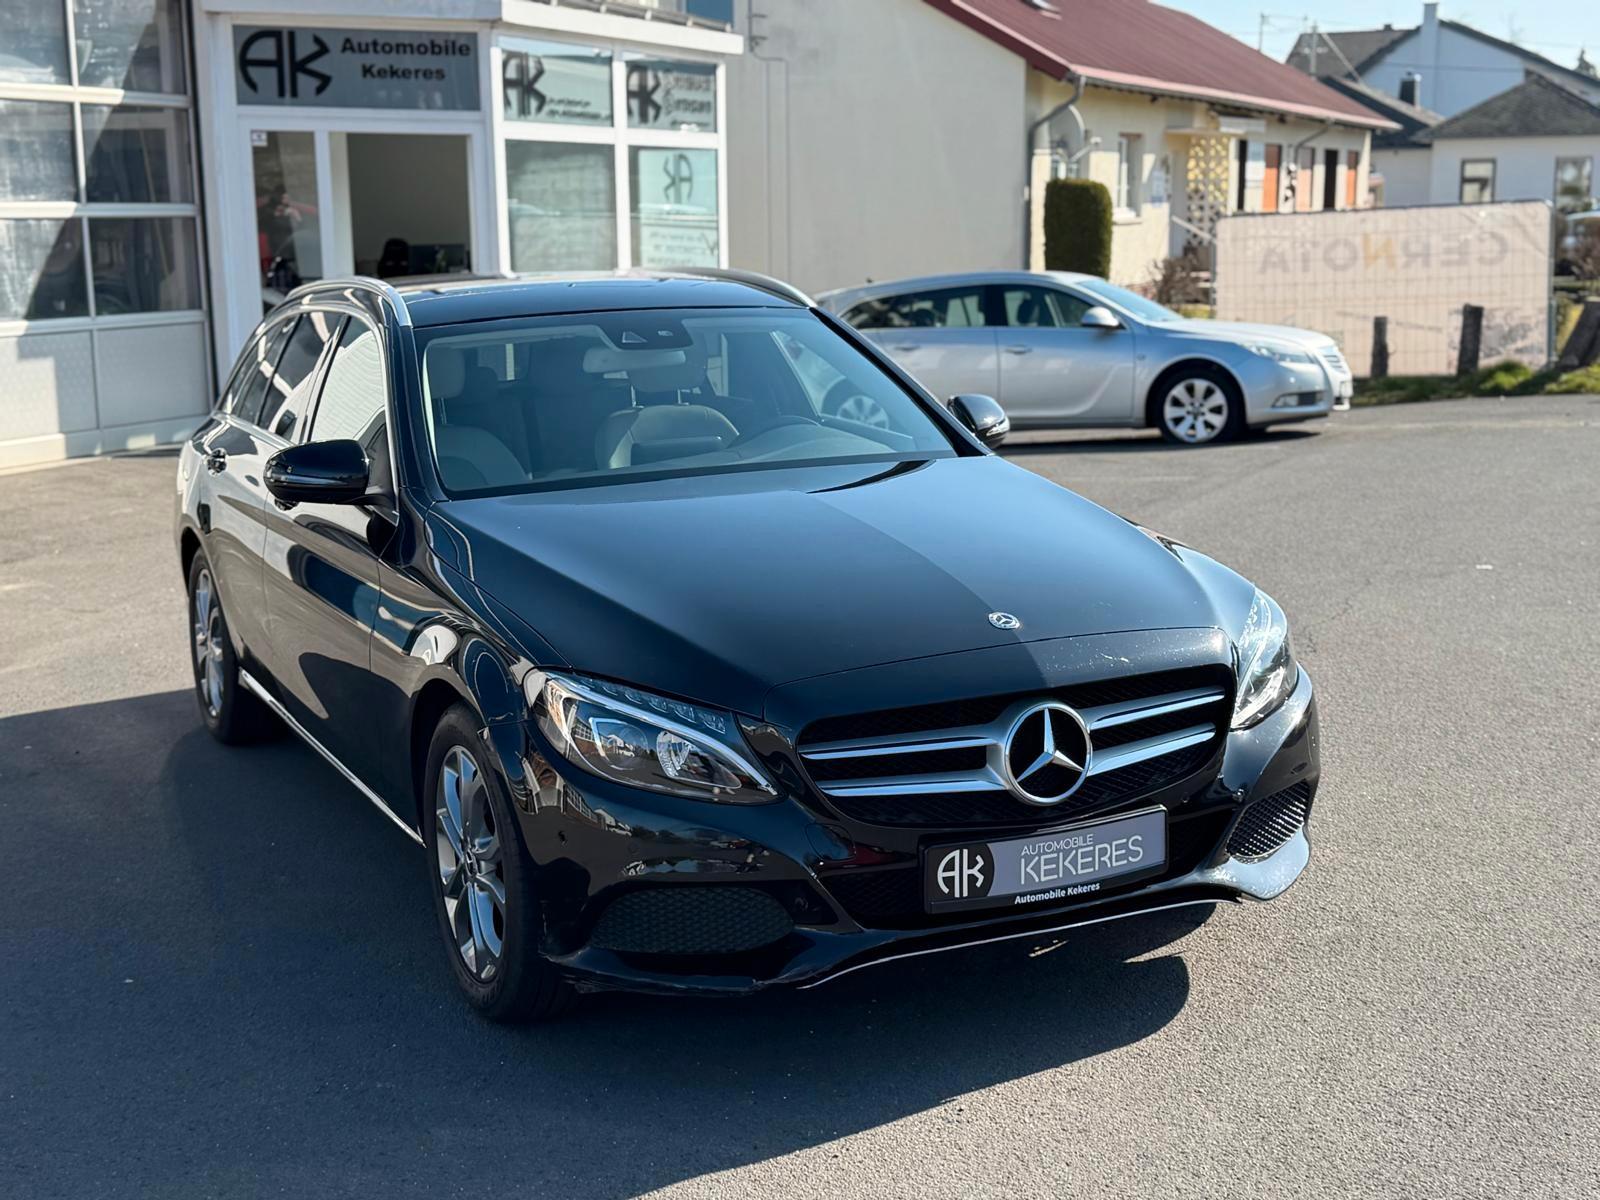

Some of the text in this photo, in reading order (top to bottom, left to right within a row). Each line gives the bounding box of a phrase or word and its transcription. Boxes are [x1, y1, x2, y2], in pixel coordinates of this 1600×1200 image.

[340, 37, 472, 57] Automobile
[238, 29, 332, 98] AK
[361, 63, 446, 81] Kekeres
[1021, 833, 1094, 857] AUTOMOBILE
[1020, 835, 1144, 885] KEKERES
[937, 848, 985, 898] AK
[1014, 882, 1101, 905] Automobile Kekeres
